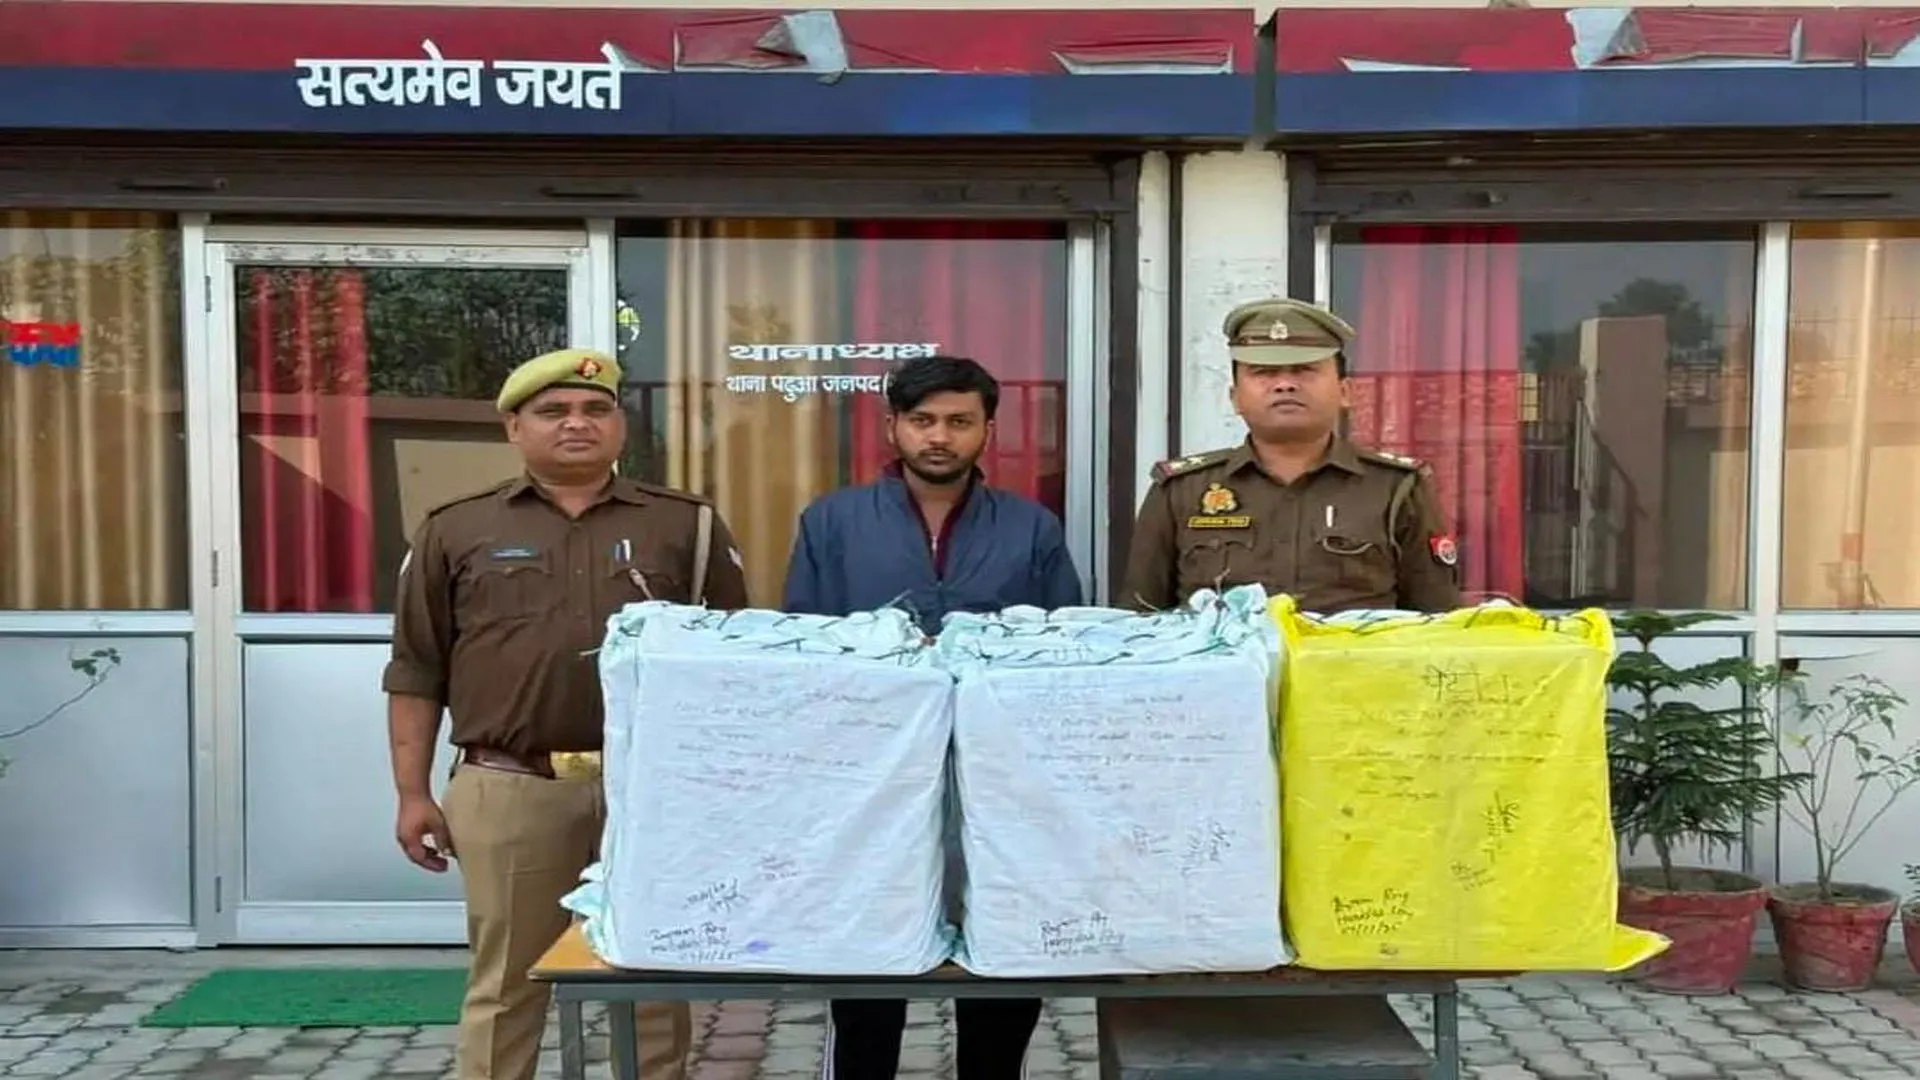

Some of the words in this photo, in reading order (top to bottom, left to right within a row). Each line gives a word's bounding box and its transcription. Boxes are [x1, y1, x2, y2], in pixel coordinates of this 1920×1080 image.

[295, 39, 484, 107] सत्यमेव
[492, 41, 622, 109] जयते
[729, 343, 940, 362] थानाध्यक्ष
[726, 375, 767, 393] थाना
